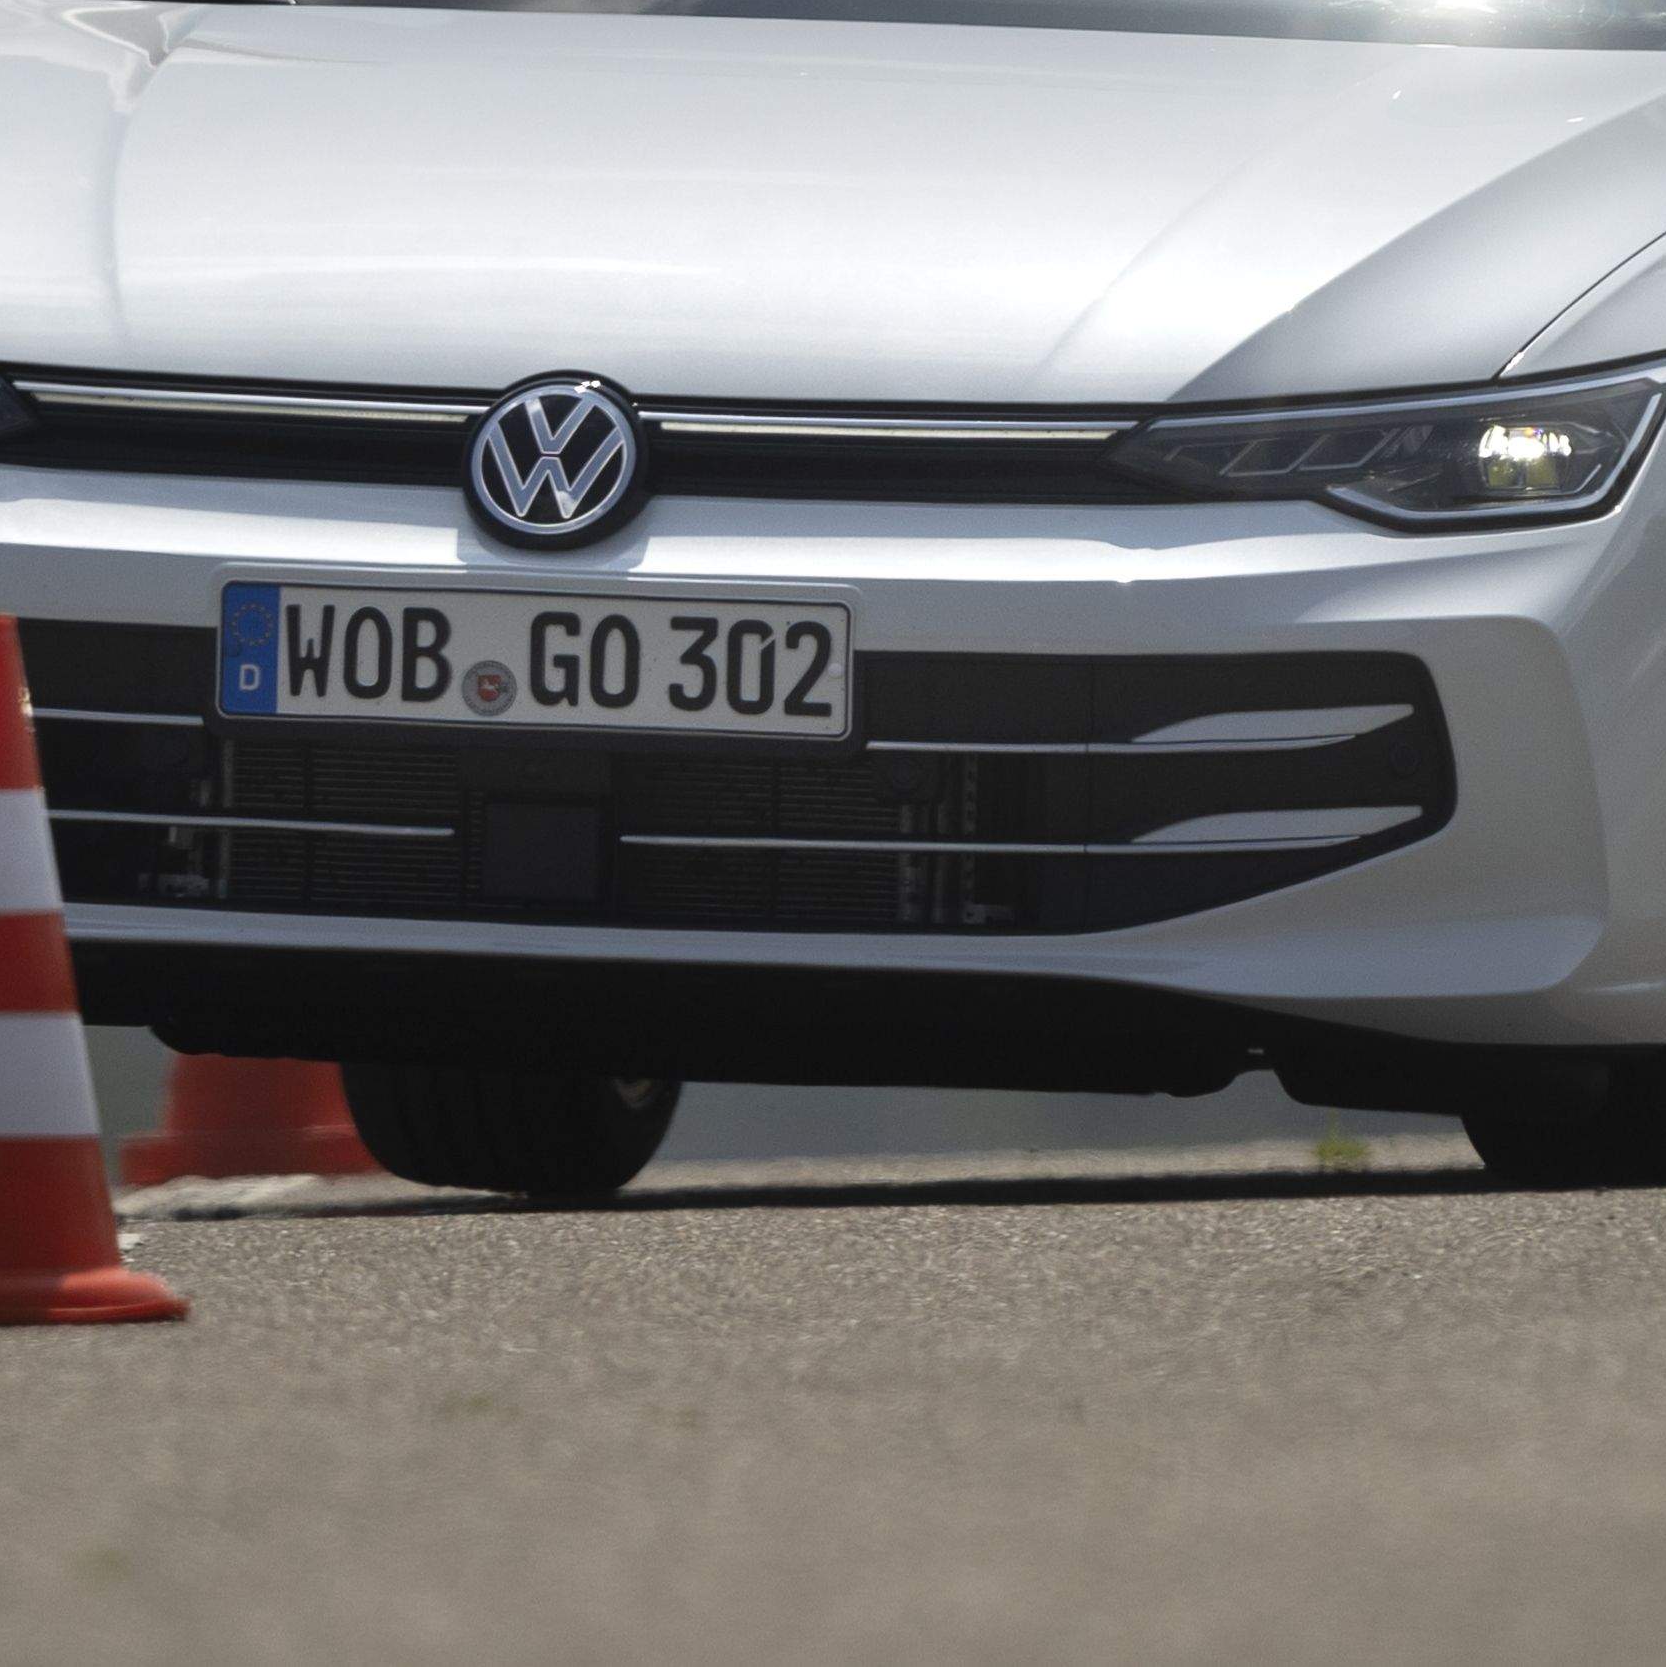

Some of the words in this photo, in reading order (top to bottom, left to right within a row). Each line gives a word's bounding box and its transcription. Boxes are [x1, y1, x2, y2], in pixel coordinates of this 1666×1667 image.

[482, 388, 629, 521] VW
[239, 664, 261, 691] D
[285, 603, 453, 703] WOB
[528, 610, 641, 709] GO
[667, 615, 833, 718] 302
